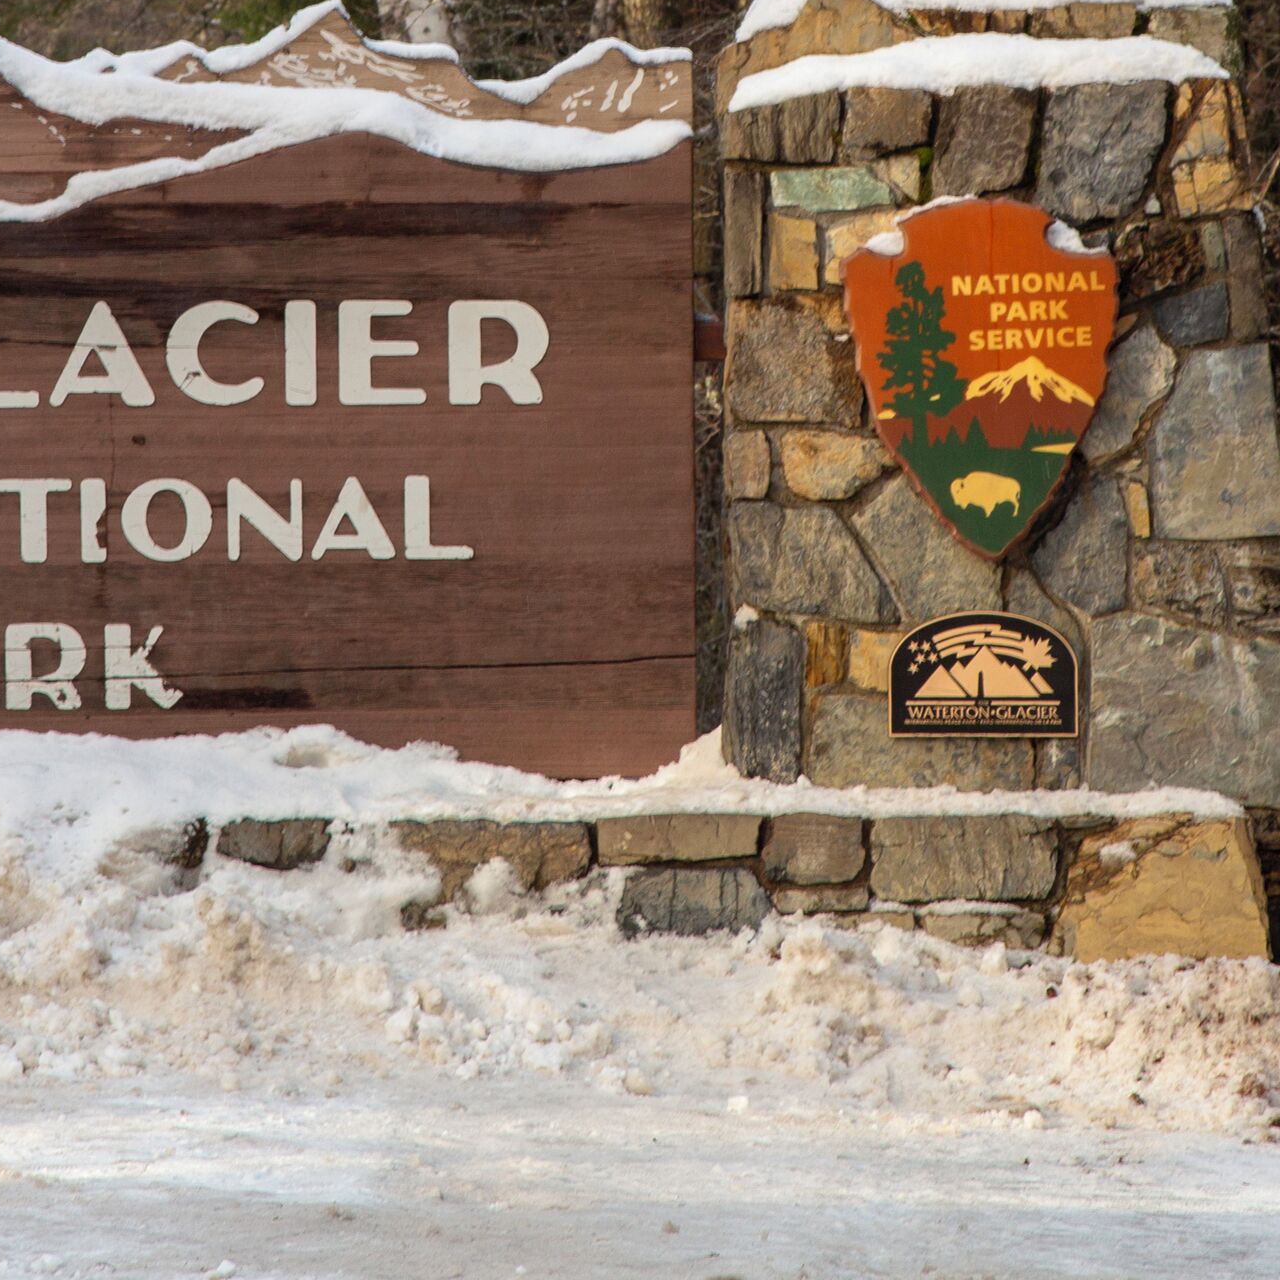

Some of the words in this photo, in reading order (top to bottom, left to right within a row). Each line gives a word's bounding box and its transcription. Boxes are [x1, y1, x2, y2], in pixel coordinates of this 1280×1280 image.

[952, 272, 1105, 296] NATIONAL
[991, 300, 1068, 322] PARK
[970, 327, 1092, 351] SERVICE
